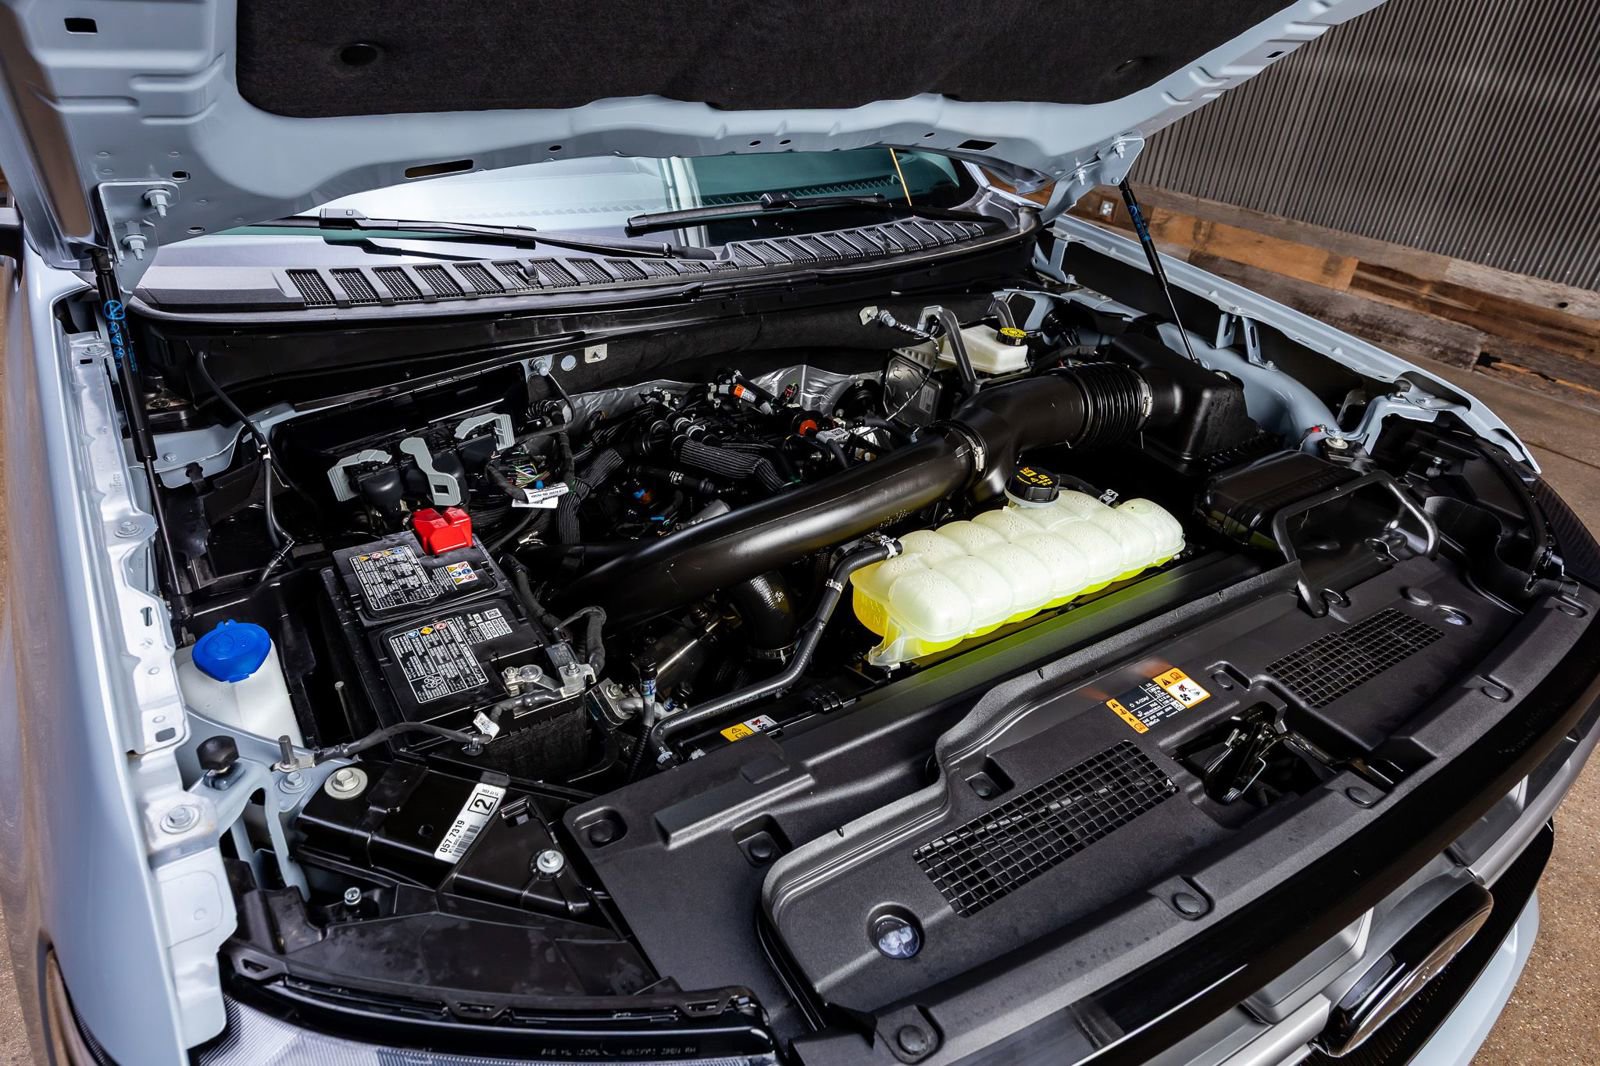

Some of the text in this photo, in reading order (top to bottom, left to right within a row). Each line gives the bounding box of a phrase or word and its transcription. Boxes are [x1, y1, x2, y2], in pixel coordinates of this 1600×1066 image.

[474, 798, 494, 811] 2
[439, 839, 453, 853] 057
[449, 820, 465, 837] 7319
